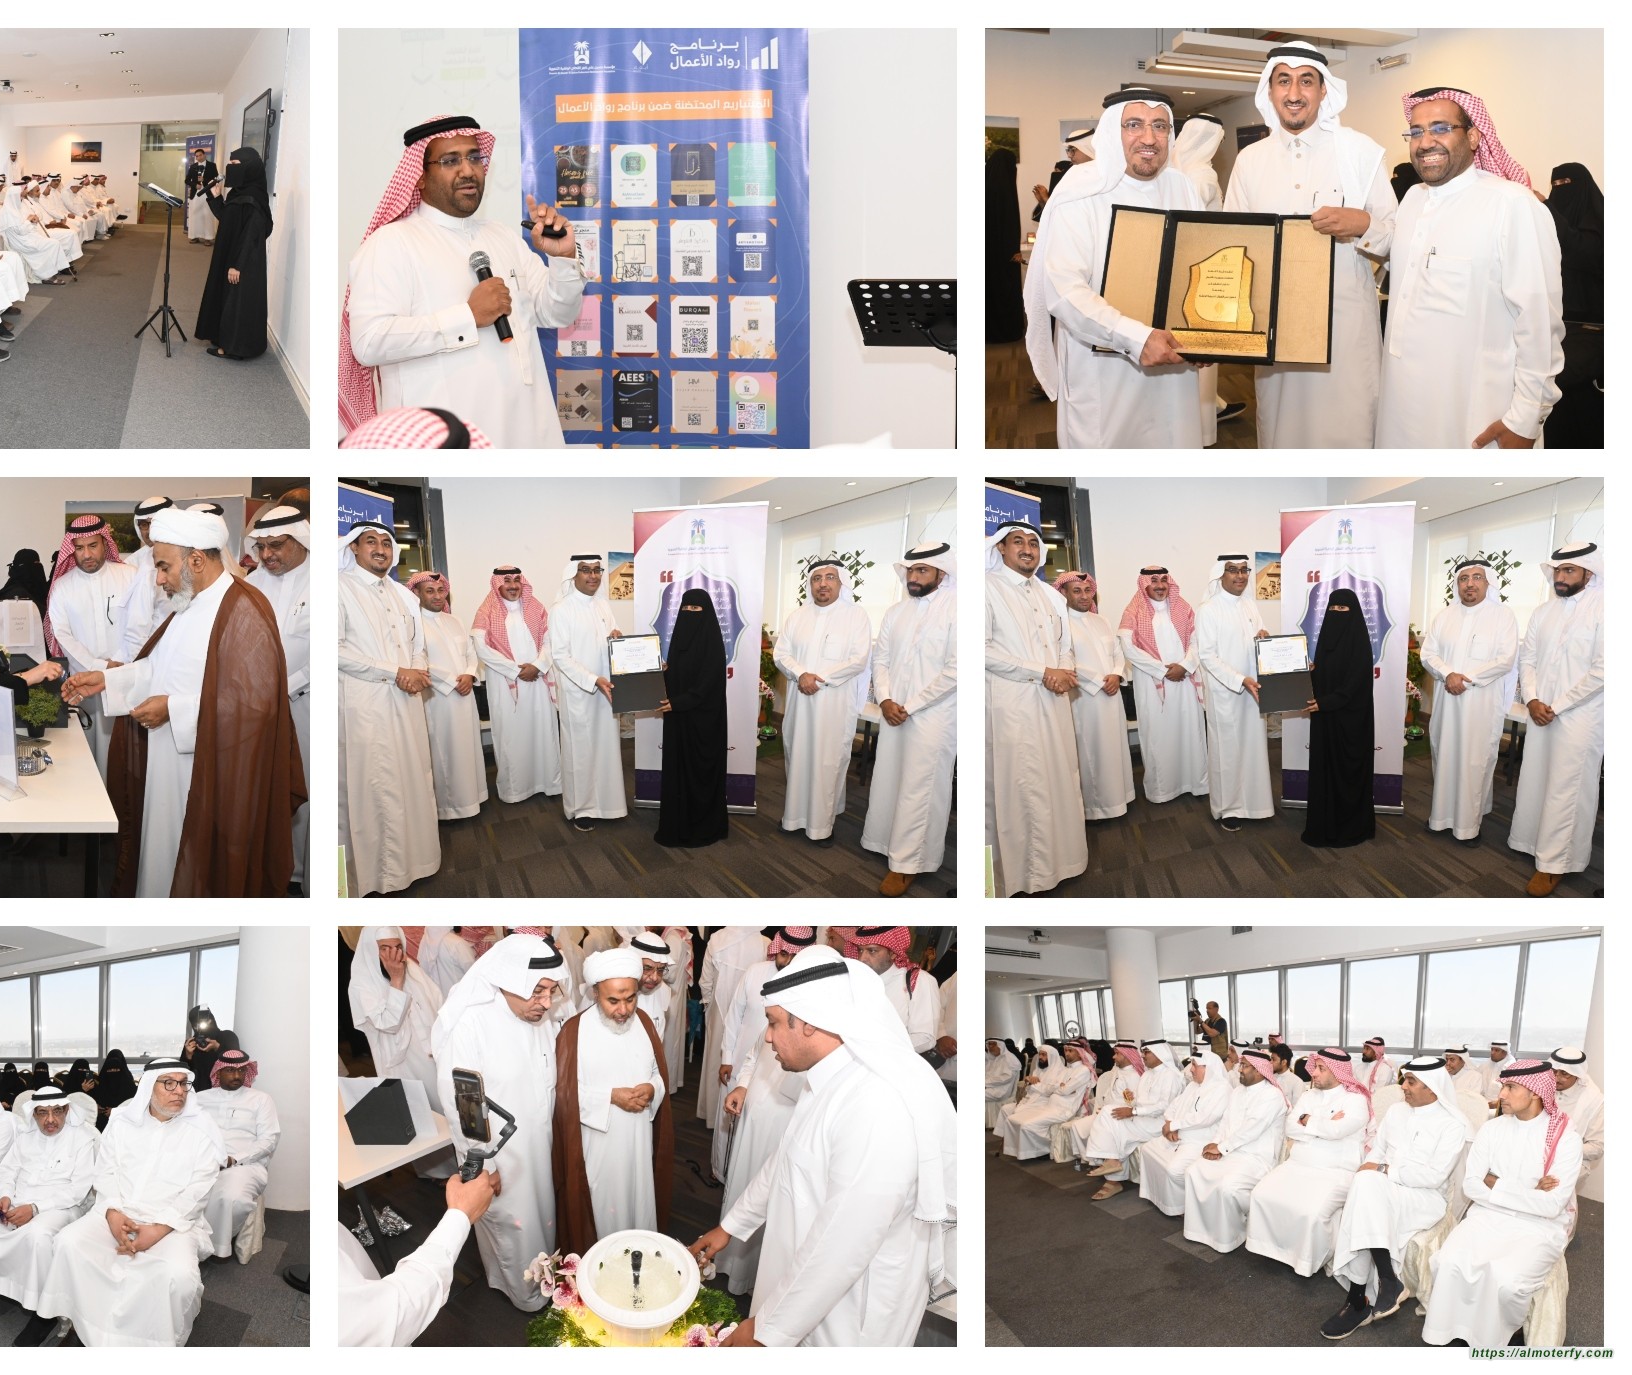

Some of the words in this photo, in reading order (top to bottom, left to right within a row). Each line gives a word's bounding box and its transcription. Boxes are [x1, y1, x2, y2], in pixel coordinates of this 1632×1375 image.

[670, 38, 739, 54] برنامج
[670, 54, 714, 70] الأعمال
[716, 57, 740, 70] رواد
[558, 101, 593, 114] الأعمال
[617, 101, 645, 114] برنامج
[648, 101, 671, 112] ضمن
[674, 100, 720, 111] المحتضنة
[723, 98, 770, 111] المشاريع
[338, 505, 364, 518] برنام
[985, 505, 1011, 518] برنام
